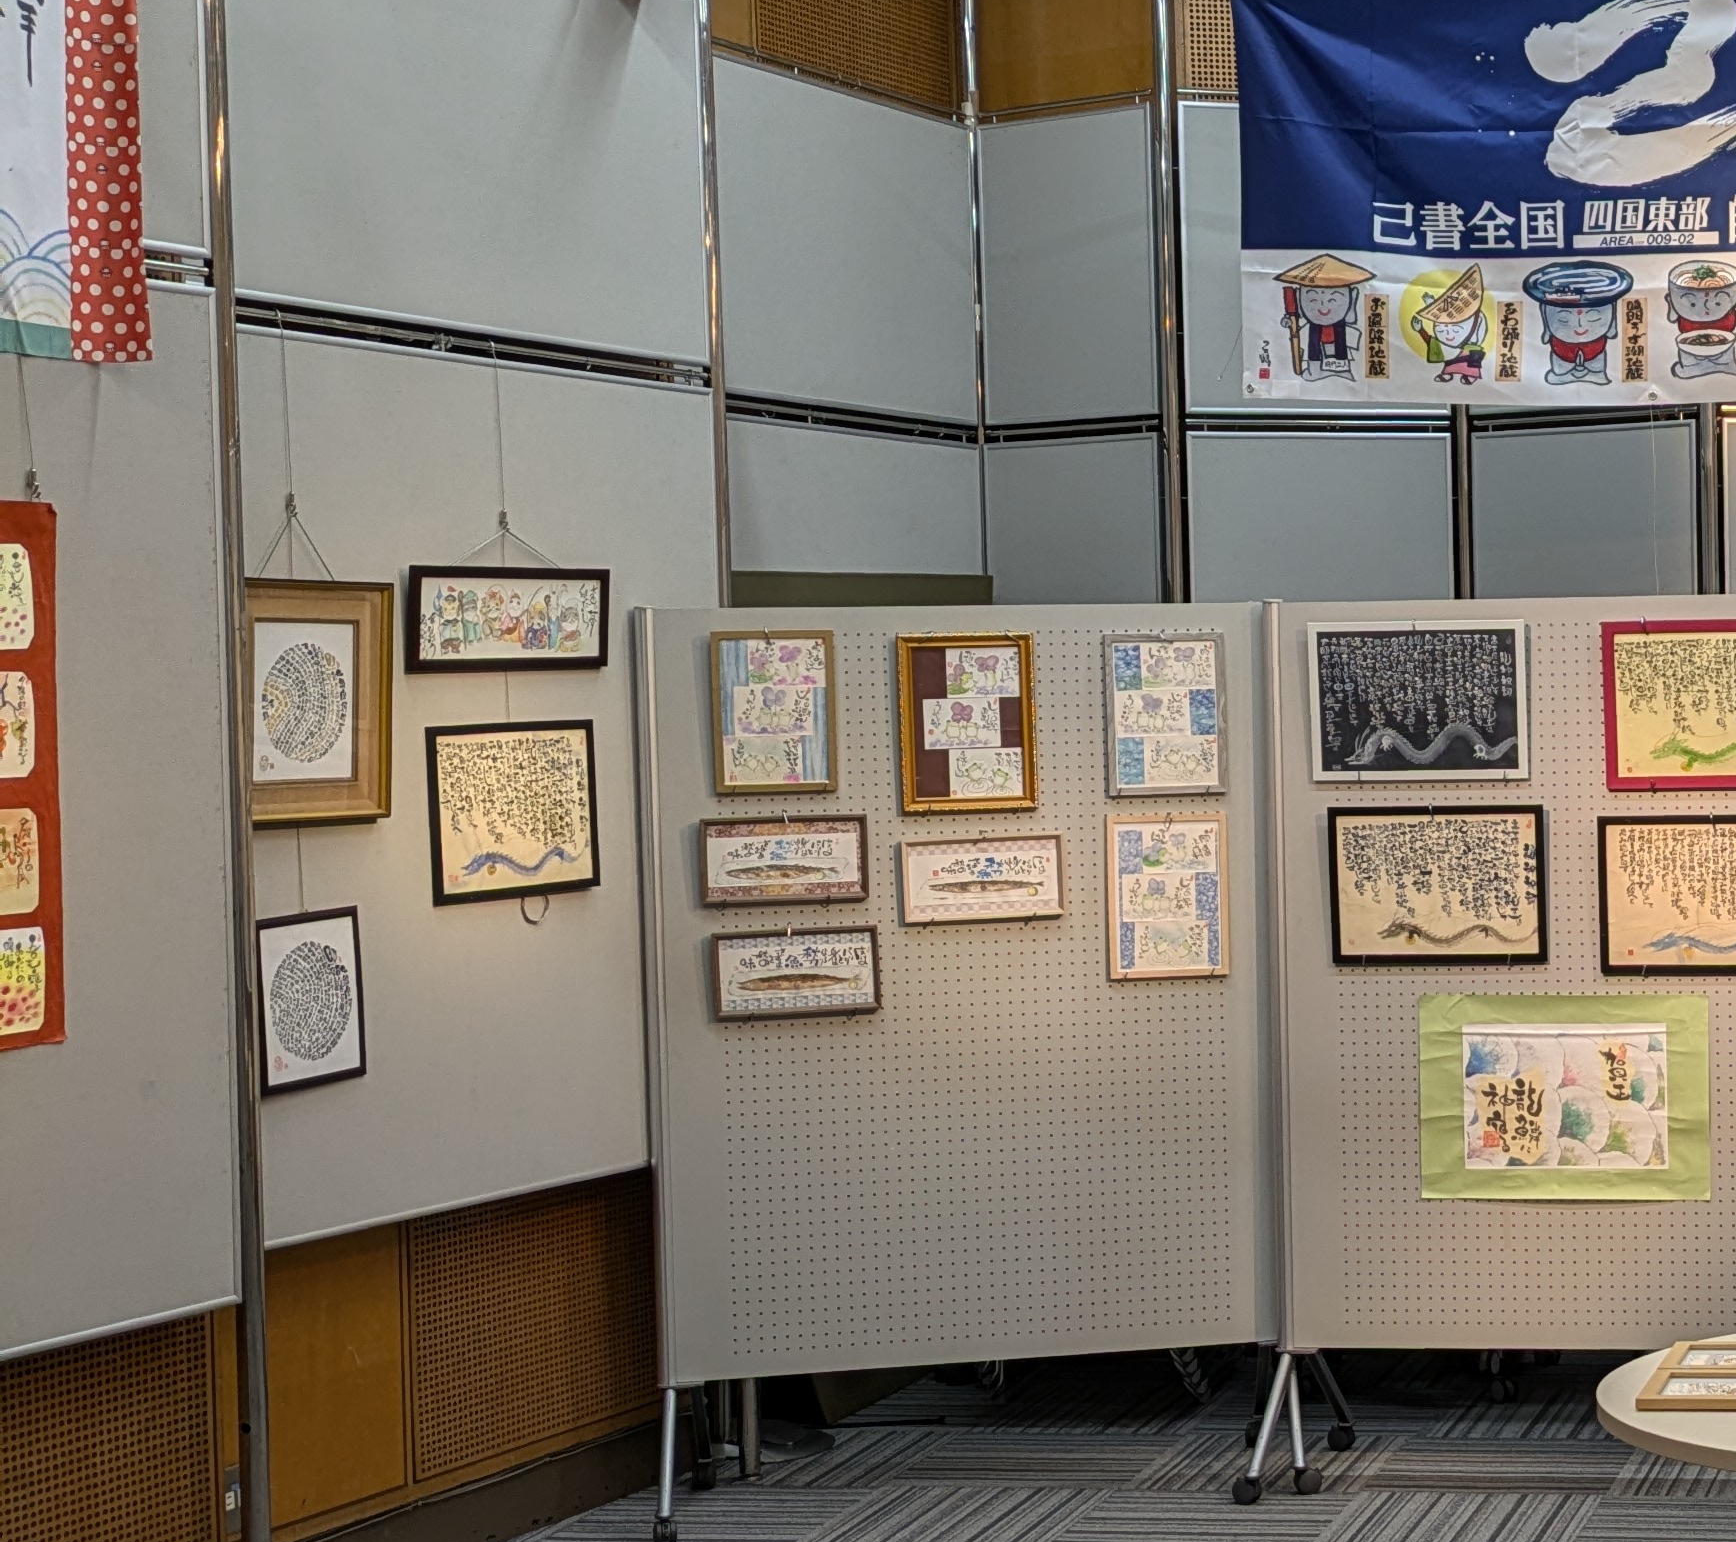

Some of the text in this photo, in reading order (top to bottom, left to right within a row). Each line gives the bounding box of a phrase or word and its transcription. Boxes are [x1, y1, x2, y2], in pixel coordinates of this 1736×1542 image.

[1372, 200, 1565, 251] 己書全国
[1582, 197, 1709, 233] 四国東部
[1600, 232, 1695, 247] AREA 009-02
[1599, 1046, 1631, 1101] 賀正
